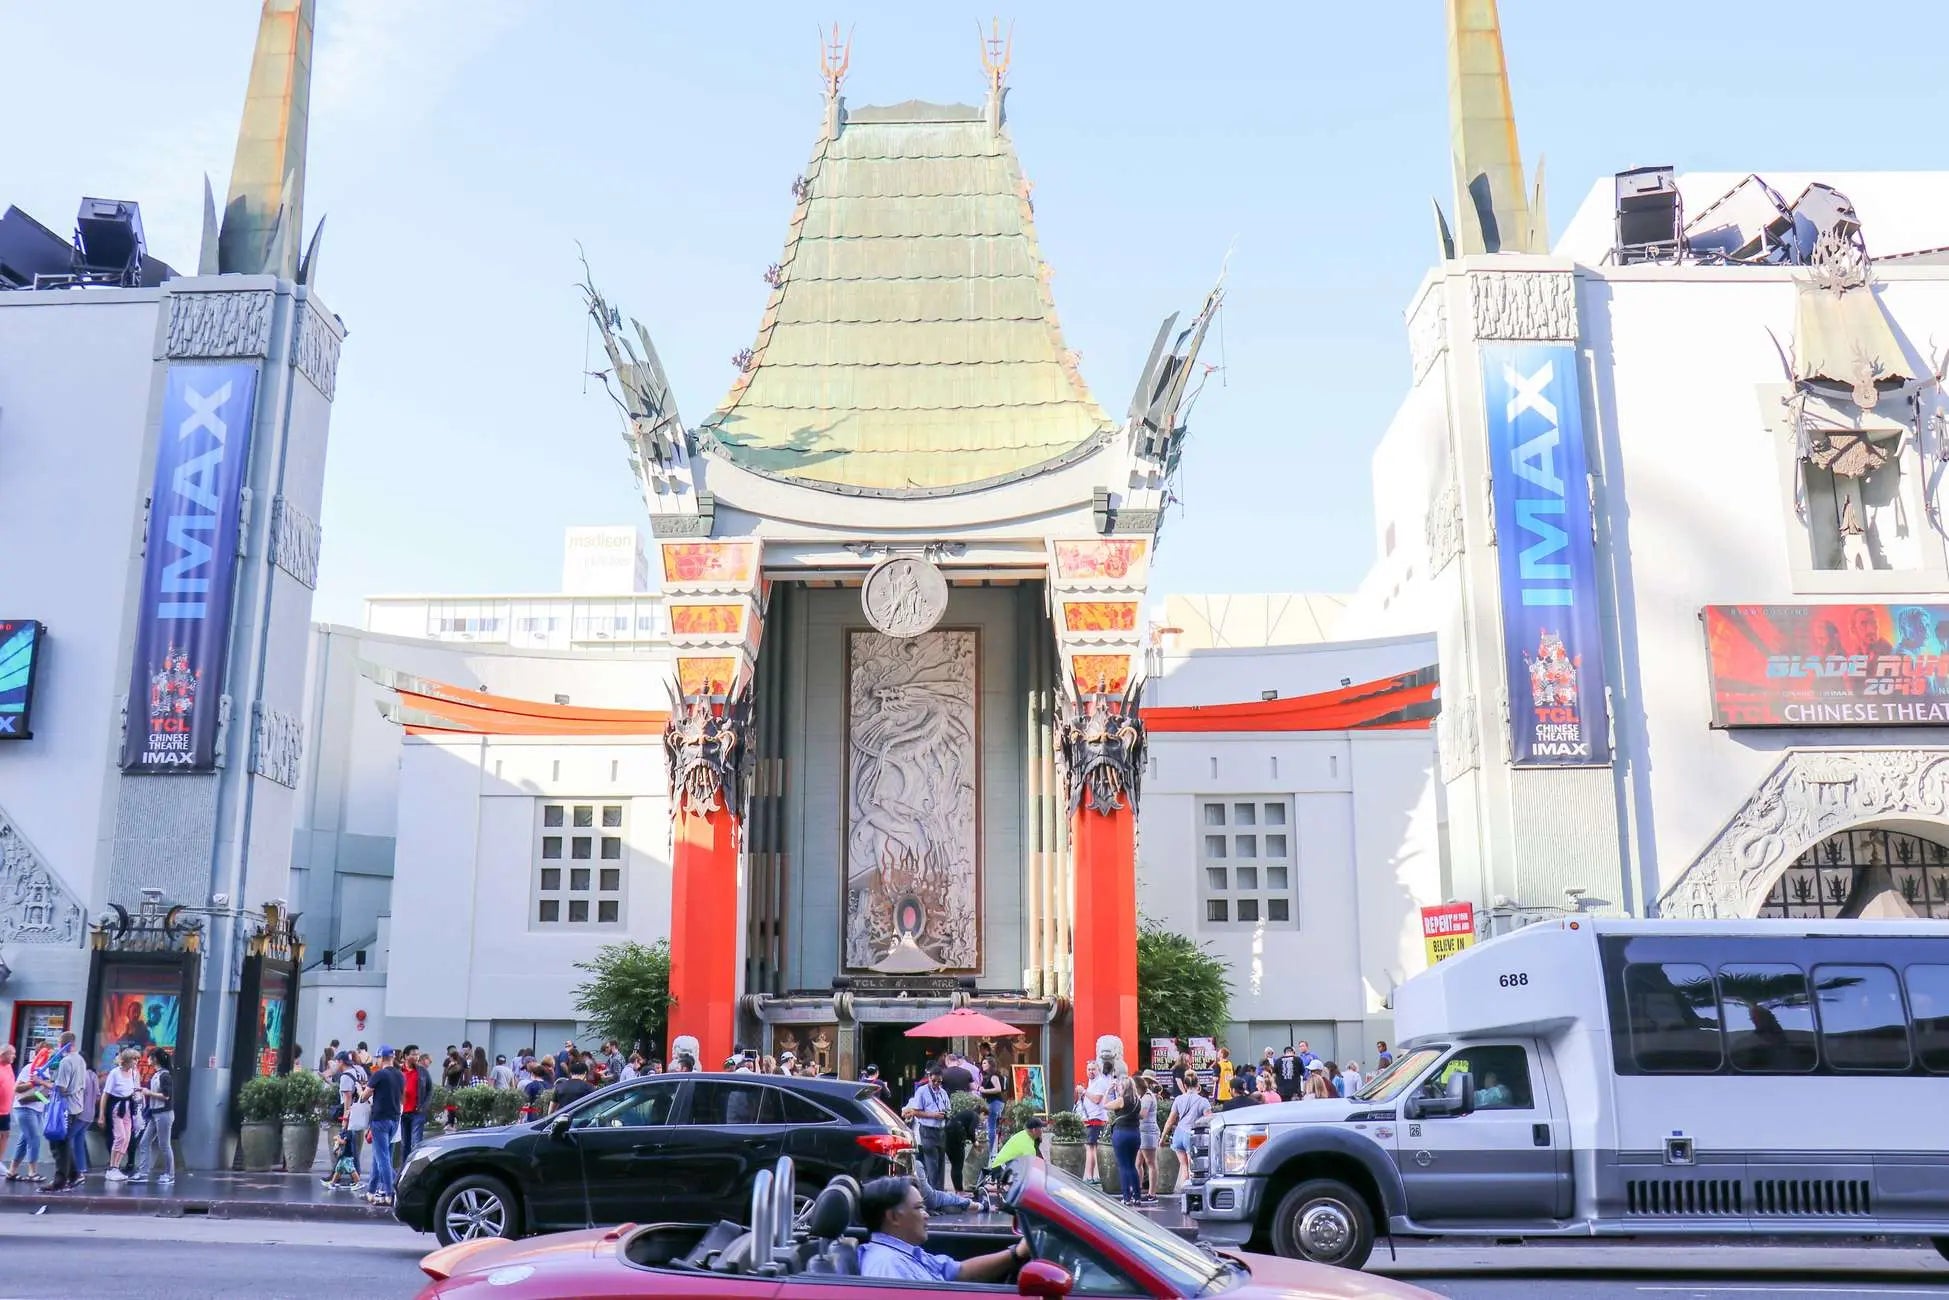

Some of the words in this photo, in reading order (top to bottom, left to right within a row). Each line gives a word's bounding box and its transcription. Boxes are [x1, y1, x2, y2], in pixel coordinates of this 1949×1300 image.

[1503, 360, 1573, 605] IMAX
[158, 380, 232, 618] IMAX
[1765, 655, 1868, 678] BLADE
[1863, 678, 1926, 696] 2049
[1535, 708, 1579, 723] TCL
[1784, 703, 1879, 721] CHINESE
[151, 718, 190, 732] TCL
[1535, 724, 1579, 733] CHINESE
[149, 733, 189, 742] CHINESE
[1536, 732, 1580, 741] THEATRE
[148, 741, 189, 750] THEATRE
[1532, 743, 1588, 755] IMAX
[142, 751, 193, 764] IMAX
[1424, 914, 1453, 935] REPENT
[1433, 939, 1455, 952] BELIEVE
[1457, 938, 1465, 950] IN
[1499, 972, 1529, 987] 688
[1154, 1049, 1168, 1057] TAKE
[1191, 1049, 1205, 1057] TAKE
[1411, 1127, 1420, 1136] 26
